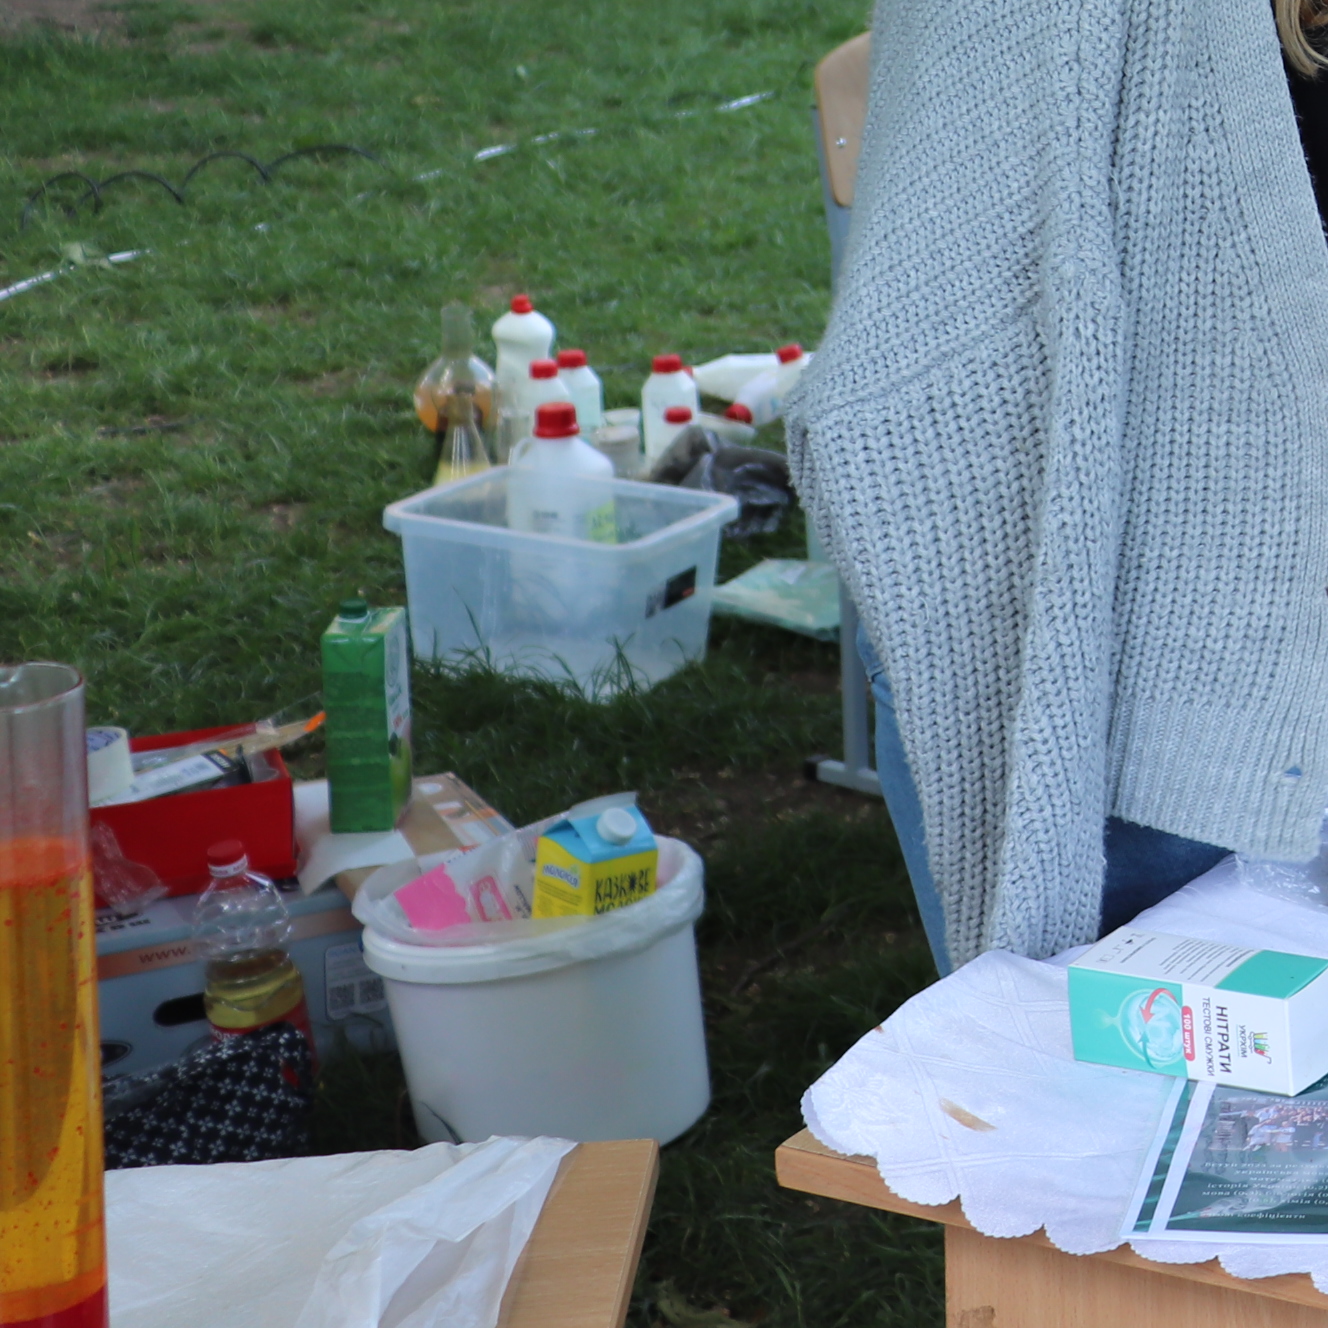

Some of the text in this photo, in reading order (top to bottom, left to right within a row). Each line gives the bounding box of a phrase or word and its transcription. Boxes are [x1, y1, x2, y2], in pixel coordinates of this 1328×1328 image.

[1183, 1013, 1192, 1054] 100 штук
[1202, 997, 1215, 1077] ТЕСТОВІ СМУЖКИ
[1215, 1005, 1232, 1074] НІТРАТИ
[1239, 1024, 1248, 1058] УКРХІМ
